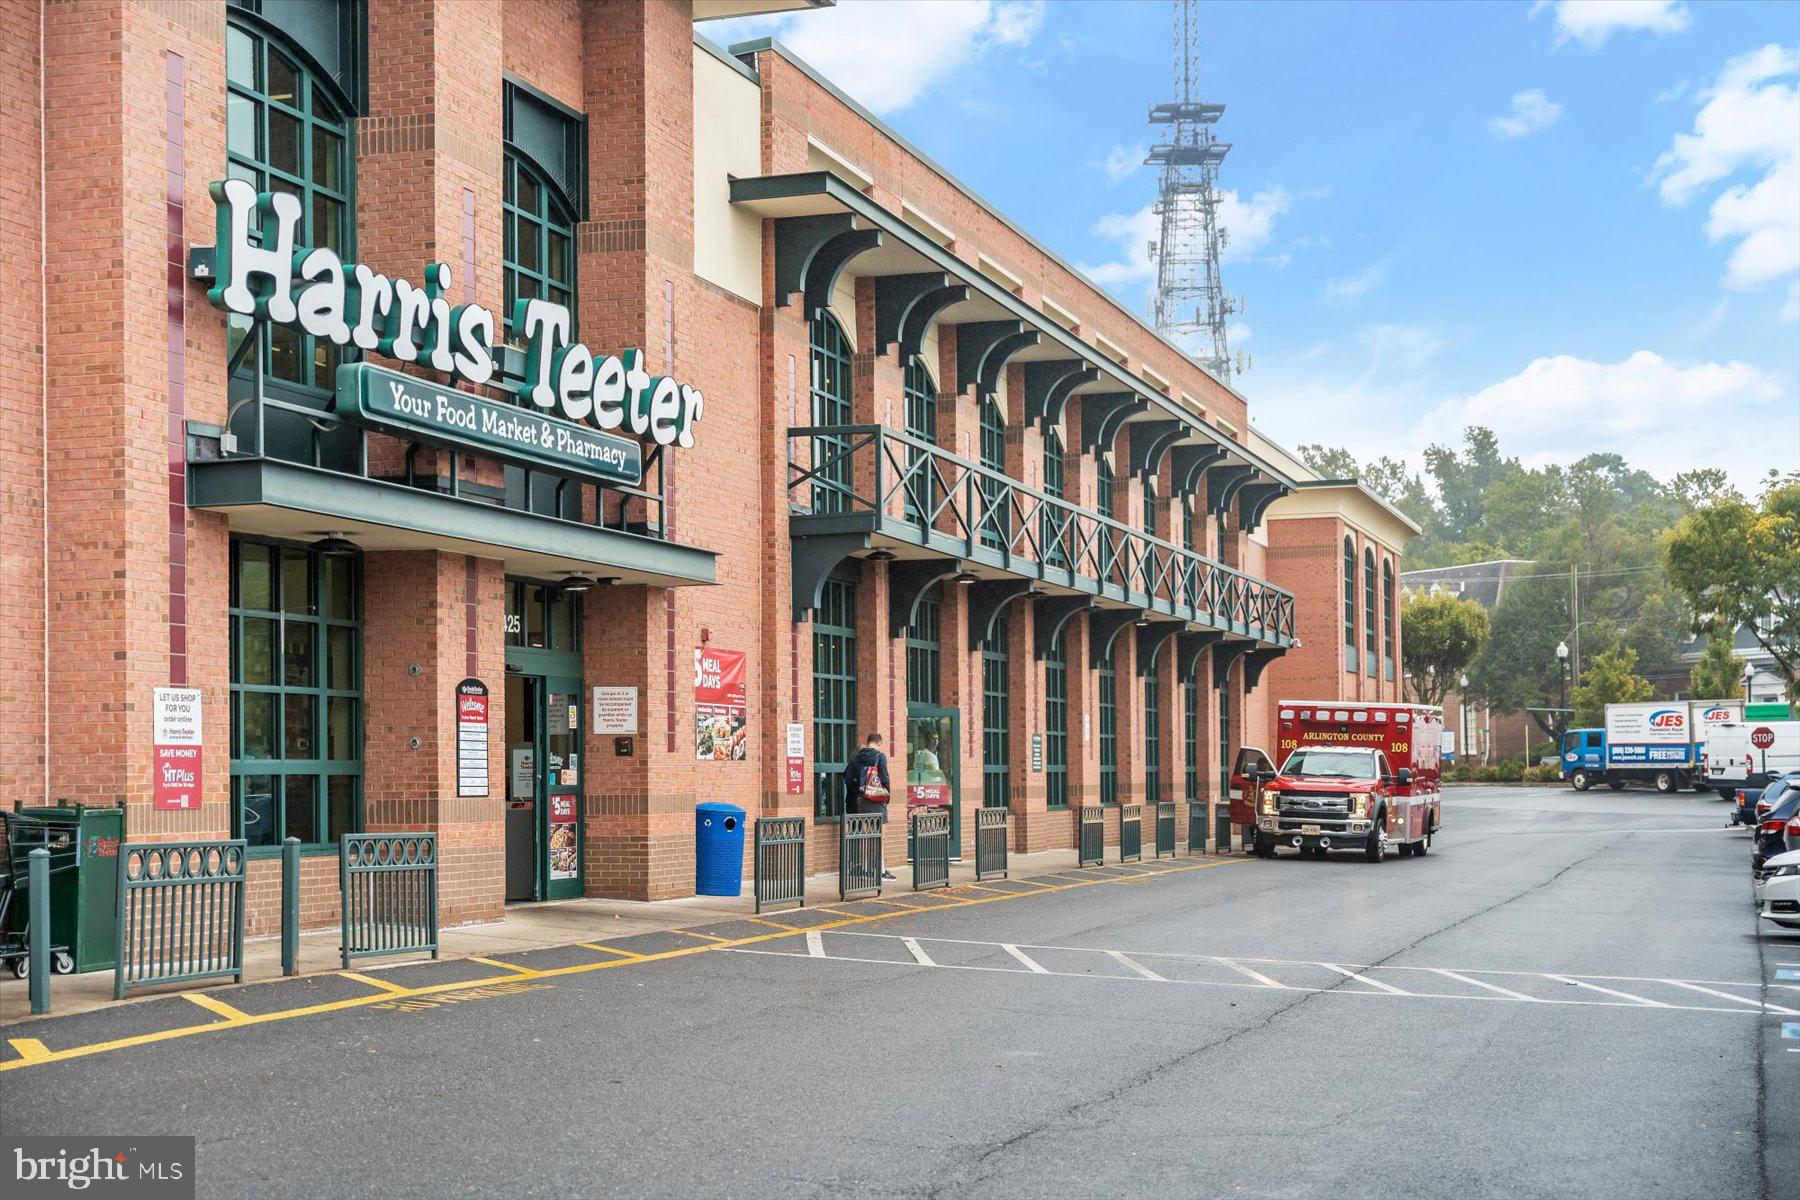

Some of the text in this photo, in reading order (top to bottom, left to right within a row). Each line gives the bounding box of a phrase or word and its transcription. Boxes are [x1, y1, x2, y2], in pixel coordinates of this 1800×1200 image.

[222, 178, 704, 448] Harris Teeter
[389, 381, 627, 471] Your Food Market & Pharmacy
[702, 657, 721, 673] MEAL
[702, 673, 721, 689] DAYS
[160, 693, 196, 702] LET US SHOP
[165, 704, 191, 713] FOR YOU
[1708, 711, 1730, 720] JES
[1655, 715, 1684, 727] JES
[1302, 732, 1385, 742] ARLINGTON COUNTY
[1752, 733, 1774, 743] STOP
[1281, 740, 1298, 749] 108
[1390, 742, 1408, 752] 108
[160, 749, 198, 758] SAVE MONEY
[1649, 751, 1668, 760] FREE
